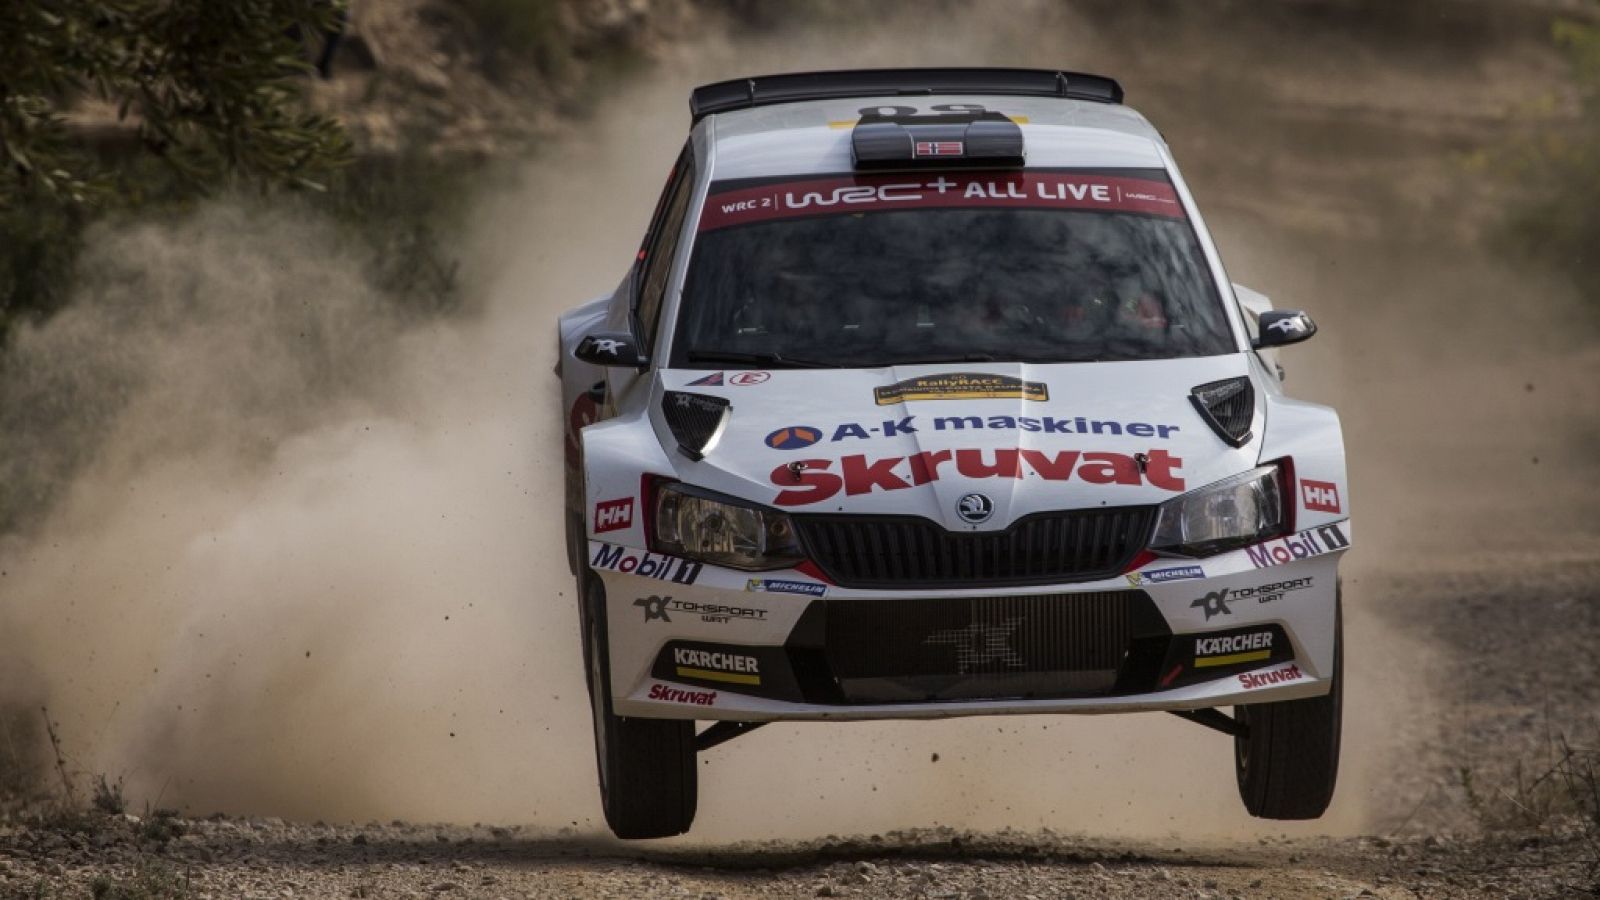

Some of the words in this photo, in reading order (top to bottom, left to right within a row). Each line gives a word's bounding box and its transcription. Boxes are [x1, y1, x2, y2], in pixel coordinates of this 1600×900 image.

[964, 182, 1027, 198] ALL
[1037, 182, 1111, 202] LIVE
[721, 200, 756, 213] WRC
[761, 198, 771, 207] 2
[831, 415, 916, 442] A-K
[933, 415, 1180, 438] maskiner
[770, 447, 1186, 506] Skruvat
[1303, 485, 1337, 507] HH
[598, 505, 631, 527] HH
[1246, 530, 1322, 569] Mobil
[592, 543, 675, 581] Mobil
[1151, 567, 1202, 580] MICHELIN
[769, 581, 825, 593] MICHELIN
[1195, 631, 1273, 656] KÄRCHER
[674, 648, 759, 673] KÄRCHER
[1238, 664, 1302, 690] Skruvat
[648, 683, 717, 705] Skruvat
